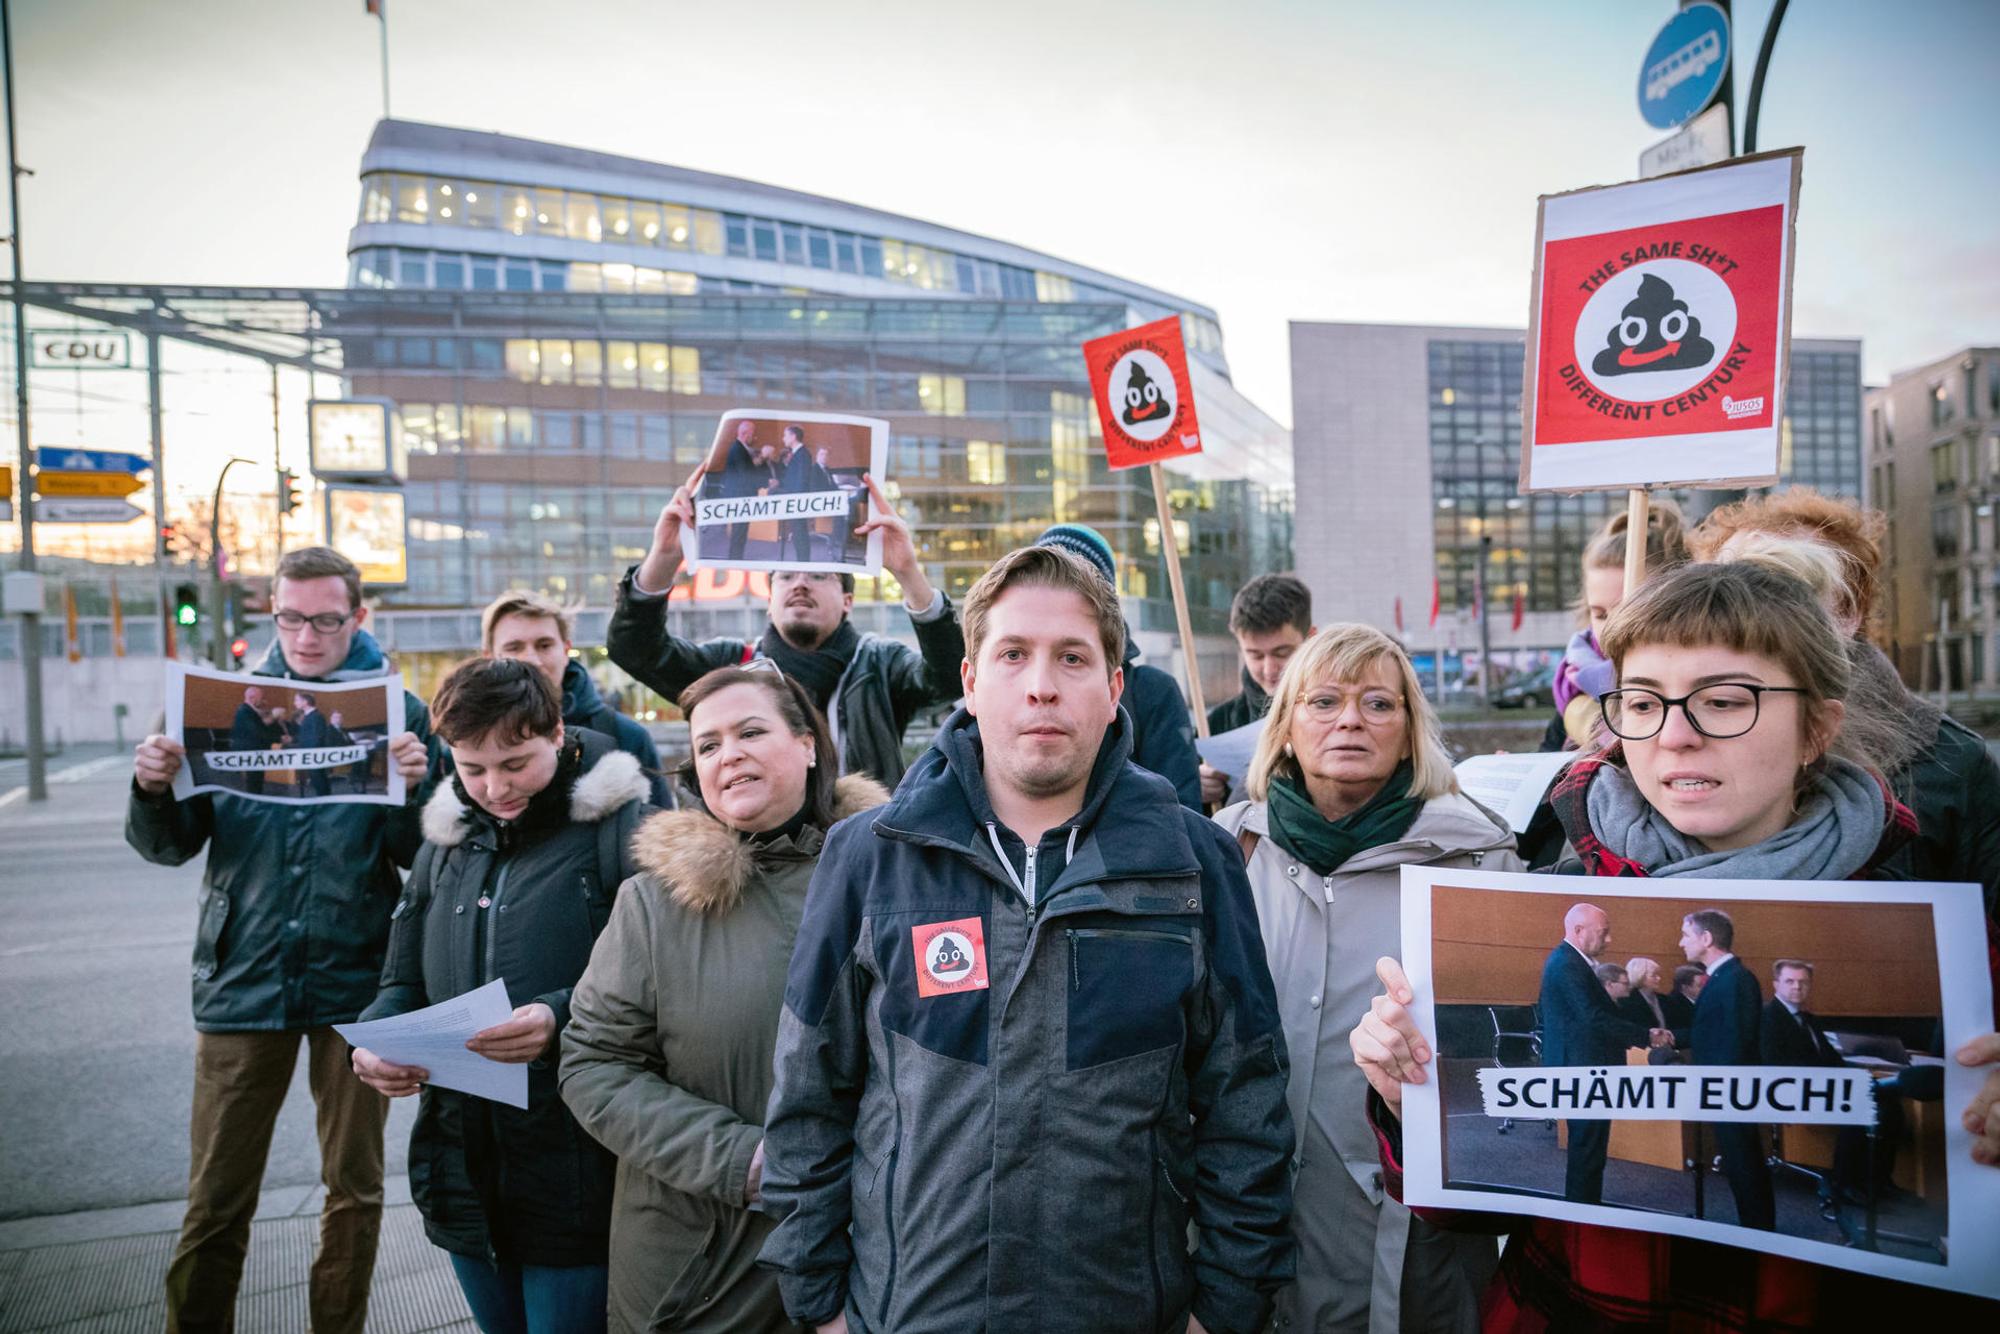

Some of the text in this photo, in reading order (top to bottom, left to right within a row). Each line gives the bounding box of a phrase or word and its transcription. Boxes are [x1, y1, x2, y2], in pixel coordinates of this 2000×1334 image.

[1579, 260, 1617, 292] THE
[1620, 242, 1683, 268] SAME
[45, 341, 114, 360] CDU
[1558, 341, 1752, 420] DIFFERENT CENTURY
[703, 496, 841, 520] SCHÄMT EUCH!
[213, 750, 360, 768] SCHÄMT EUCH!
[1497, 1069, 1853, 1113] SCHÄMT EUCH!
